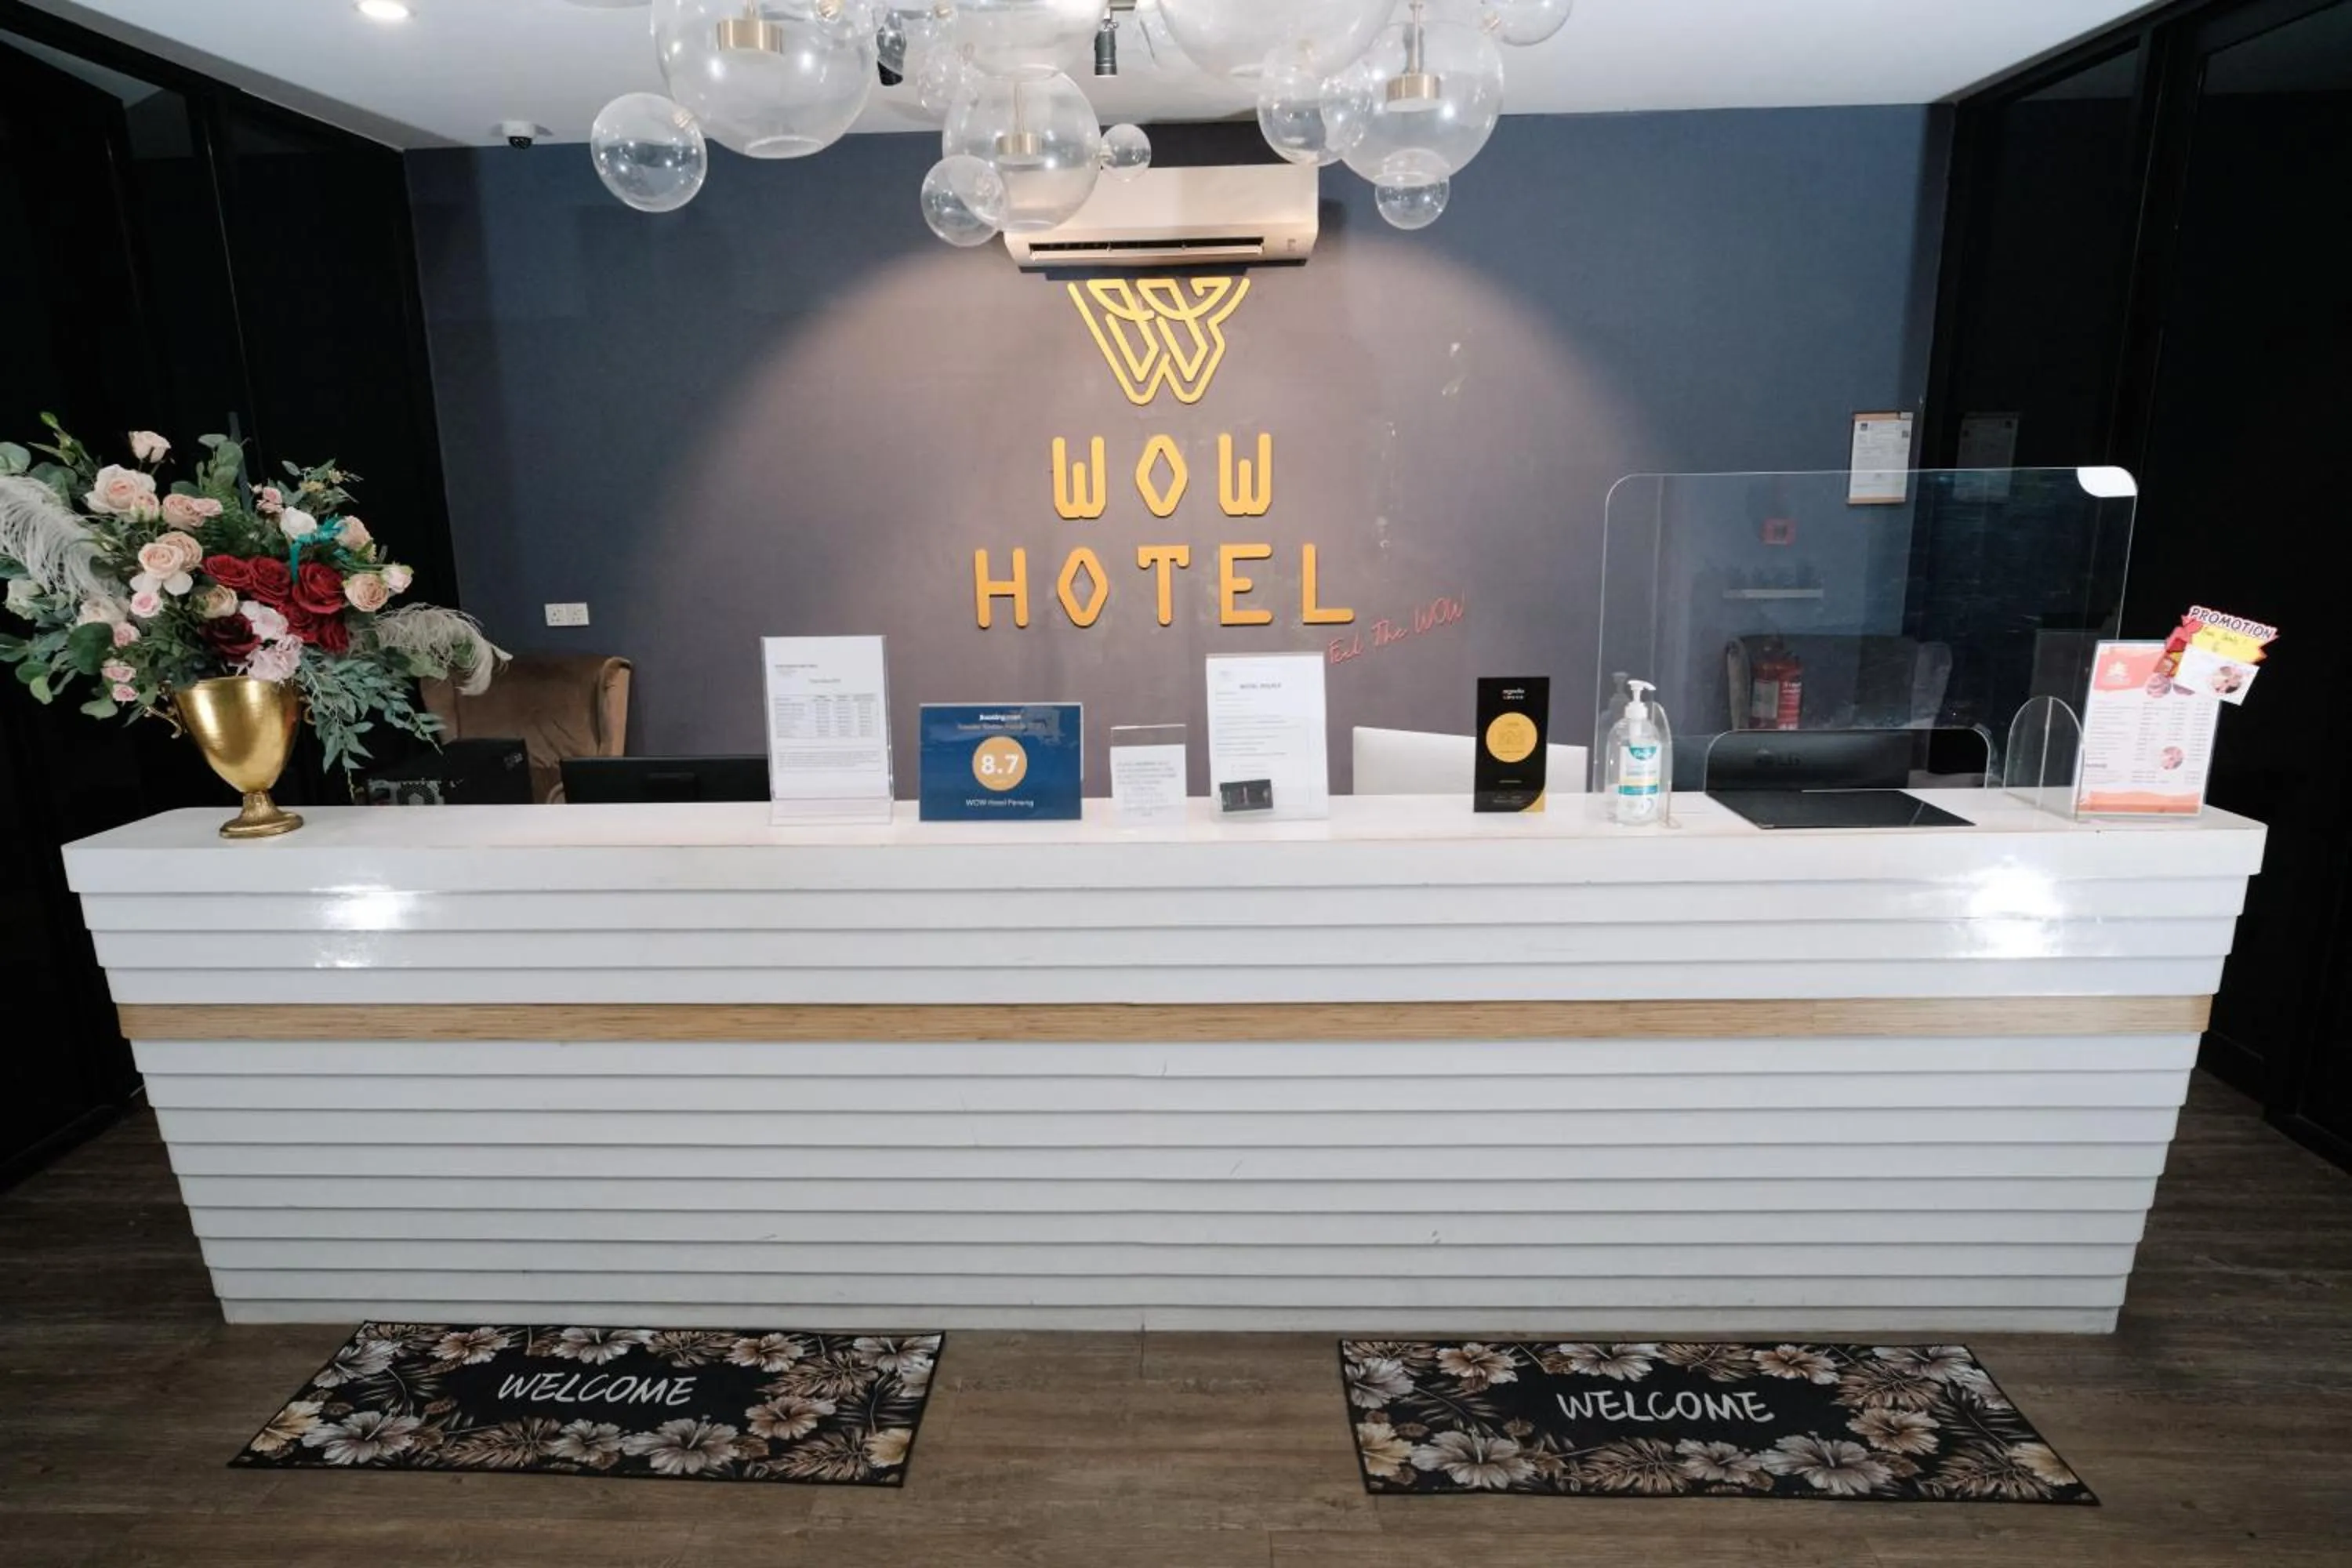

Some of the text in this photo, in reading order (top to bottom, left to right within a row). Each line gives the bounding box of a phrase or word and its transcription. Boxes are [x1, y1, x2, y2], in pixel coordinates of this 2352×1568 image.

[1052, 433, 1272, 519] WOW
[975, 544, 1356, 628] HOTEL
[2191, 608, 2273, 639] PROMOTION
[982, 754, 1018, 775] 8.7
[498, 1372, 697, 1406] WELCOME
[1556, 1390, 1775, 1422] WELCOME
